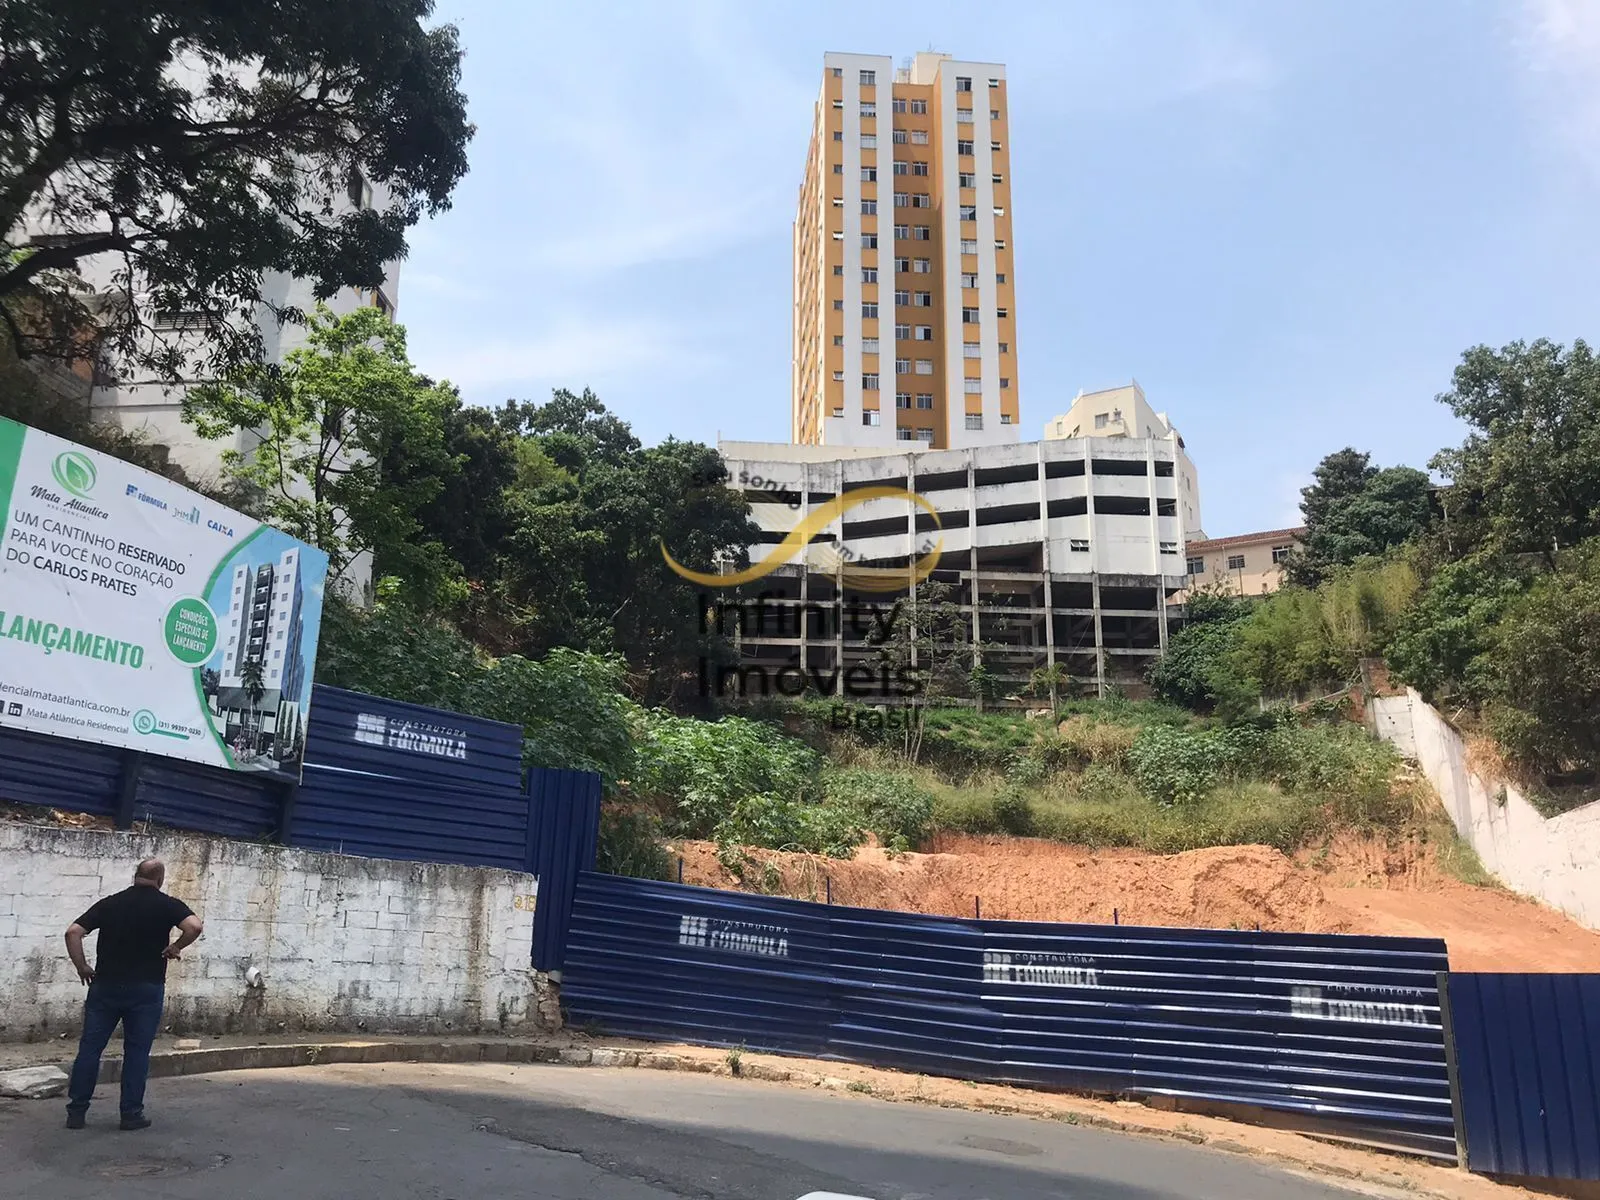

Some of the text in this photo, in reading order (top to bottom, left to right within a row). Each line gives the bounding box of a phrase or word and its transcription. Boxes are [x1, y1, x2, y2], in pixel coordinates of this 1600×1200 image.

[31, 485, 61, 503] Mata
[207, 519, 234, 537] CAIXA
[14, 509, 186, 575] UM CANTINHO RESERVADO
[10, 528, 174, 589] PARA VOCÊ NO CORAÇÃO
[6, 548, 138, 597] DO CARLOS PRATES
[0, 611, 144, 669] LANÇAMENTO
[26, 707, 48, 720] Mata
[86, 719, 129, 734] Residencial
[390, 718, 467, 738] CONSTRUTORA
[388, 726, 467, 760] FÓRMULA
[713, 918, 789, 934] CONSTRUTORA
[1015, 952, 1096, 964] CONSTRUTORA
[1327, 983, 1423, 998] CONSTRUTORA
